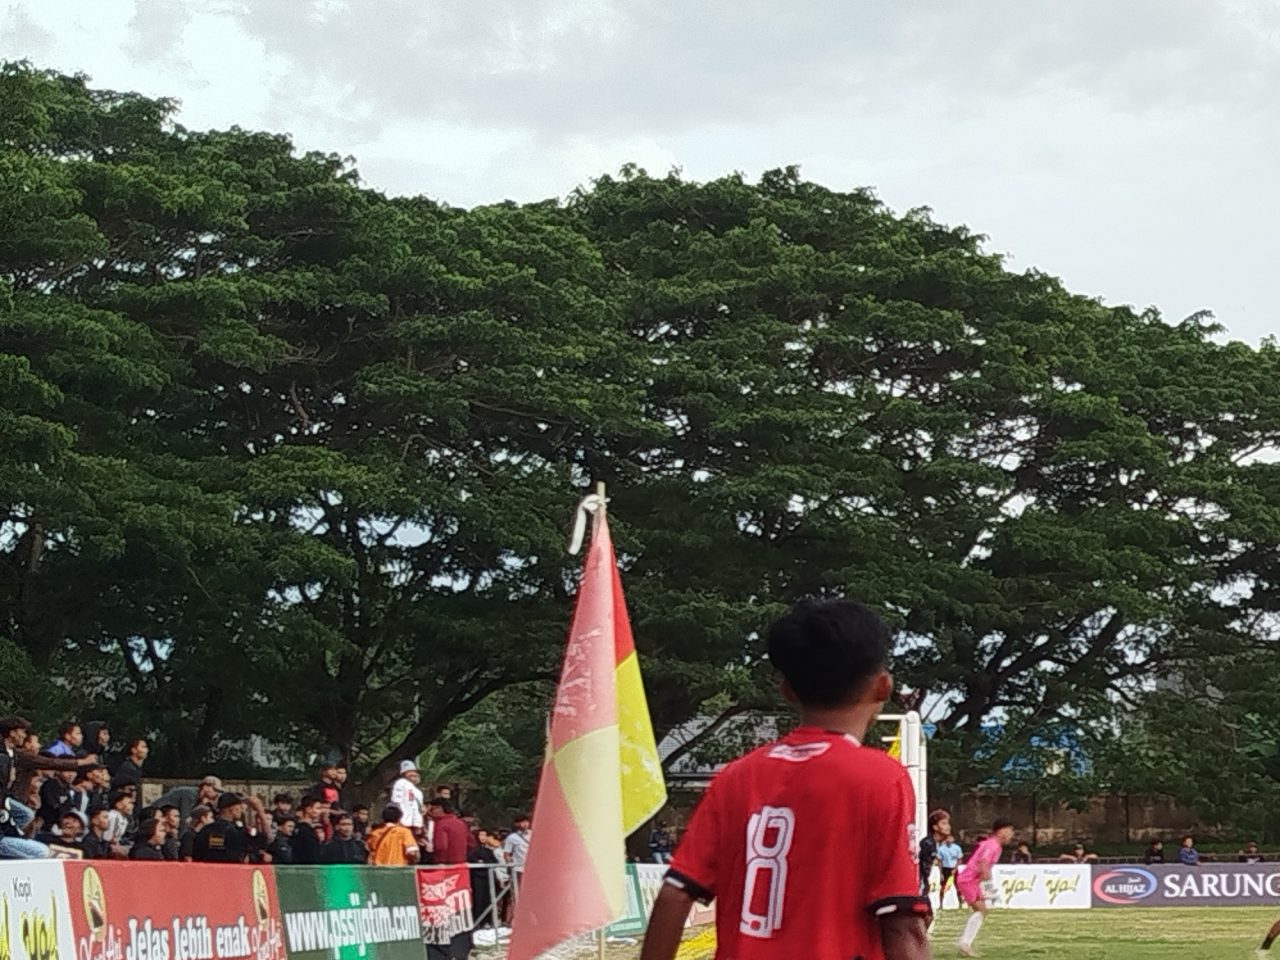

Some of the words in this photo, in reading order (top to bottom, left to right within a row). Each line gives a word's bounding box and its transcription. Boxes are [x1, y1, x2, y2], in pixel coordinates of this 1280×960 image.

[12, 876, 33, 902] Kopi
[739, 805, 796, 939] 8
[1105, 884, 1119, 894] AL
[216, 915, 252, 959] enak
